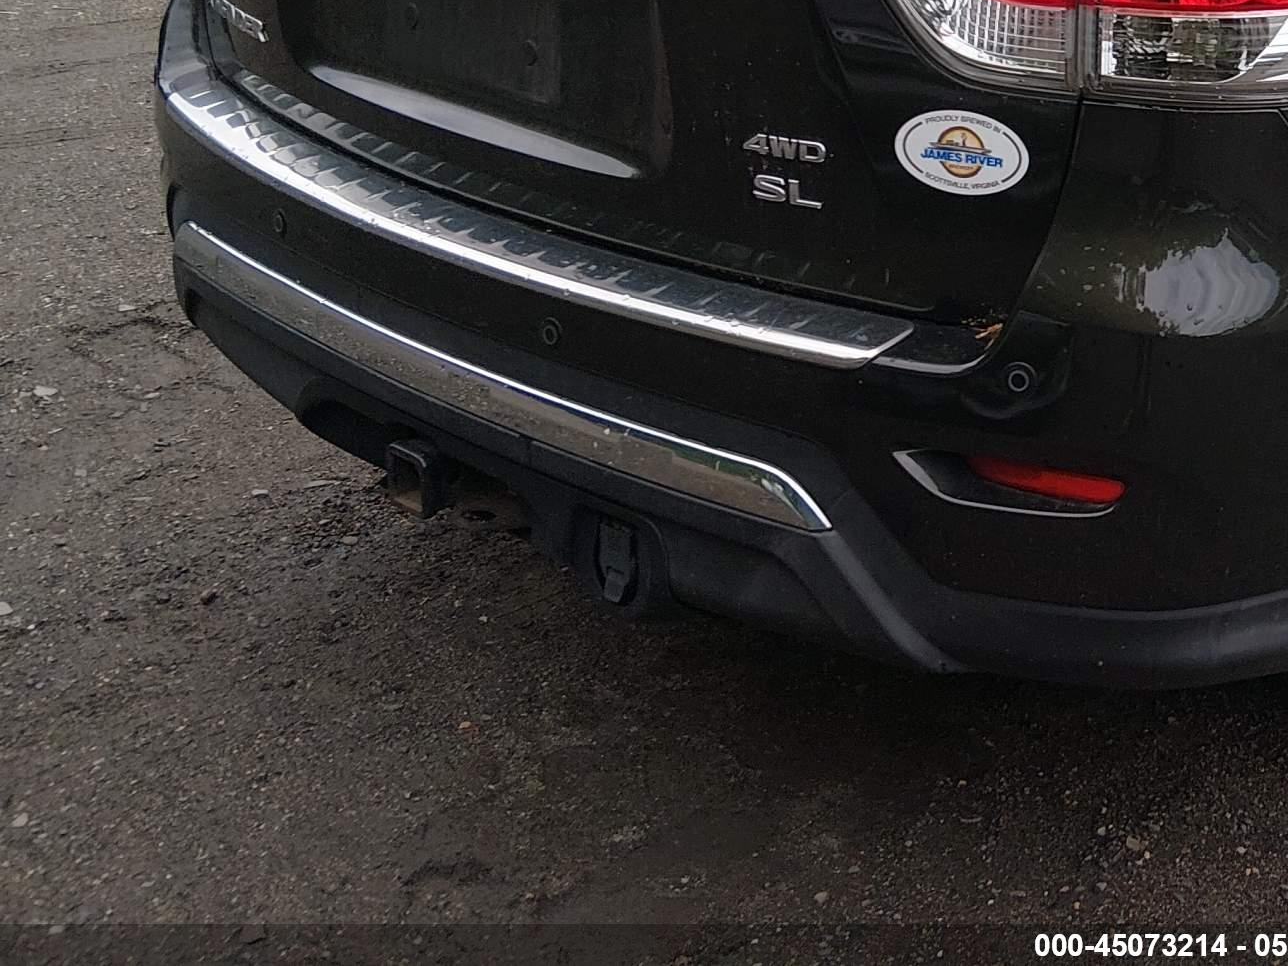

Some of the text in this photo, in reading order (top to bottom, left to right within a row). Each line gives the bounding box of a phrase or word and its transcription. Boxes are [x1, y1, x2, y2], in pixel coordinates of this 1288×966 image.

[742, 133, 827, 164] 4WD
[920, 148, 963, 163] JAMES
[965, 153, 1004, 168] RIVER
[752, 174, 824, 210] SL
